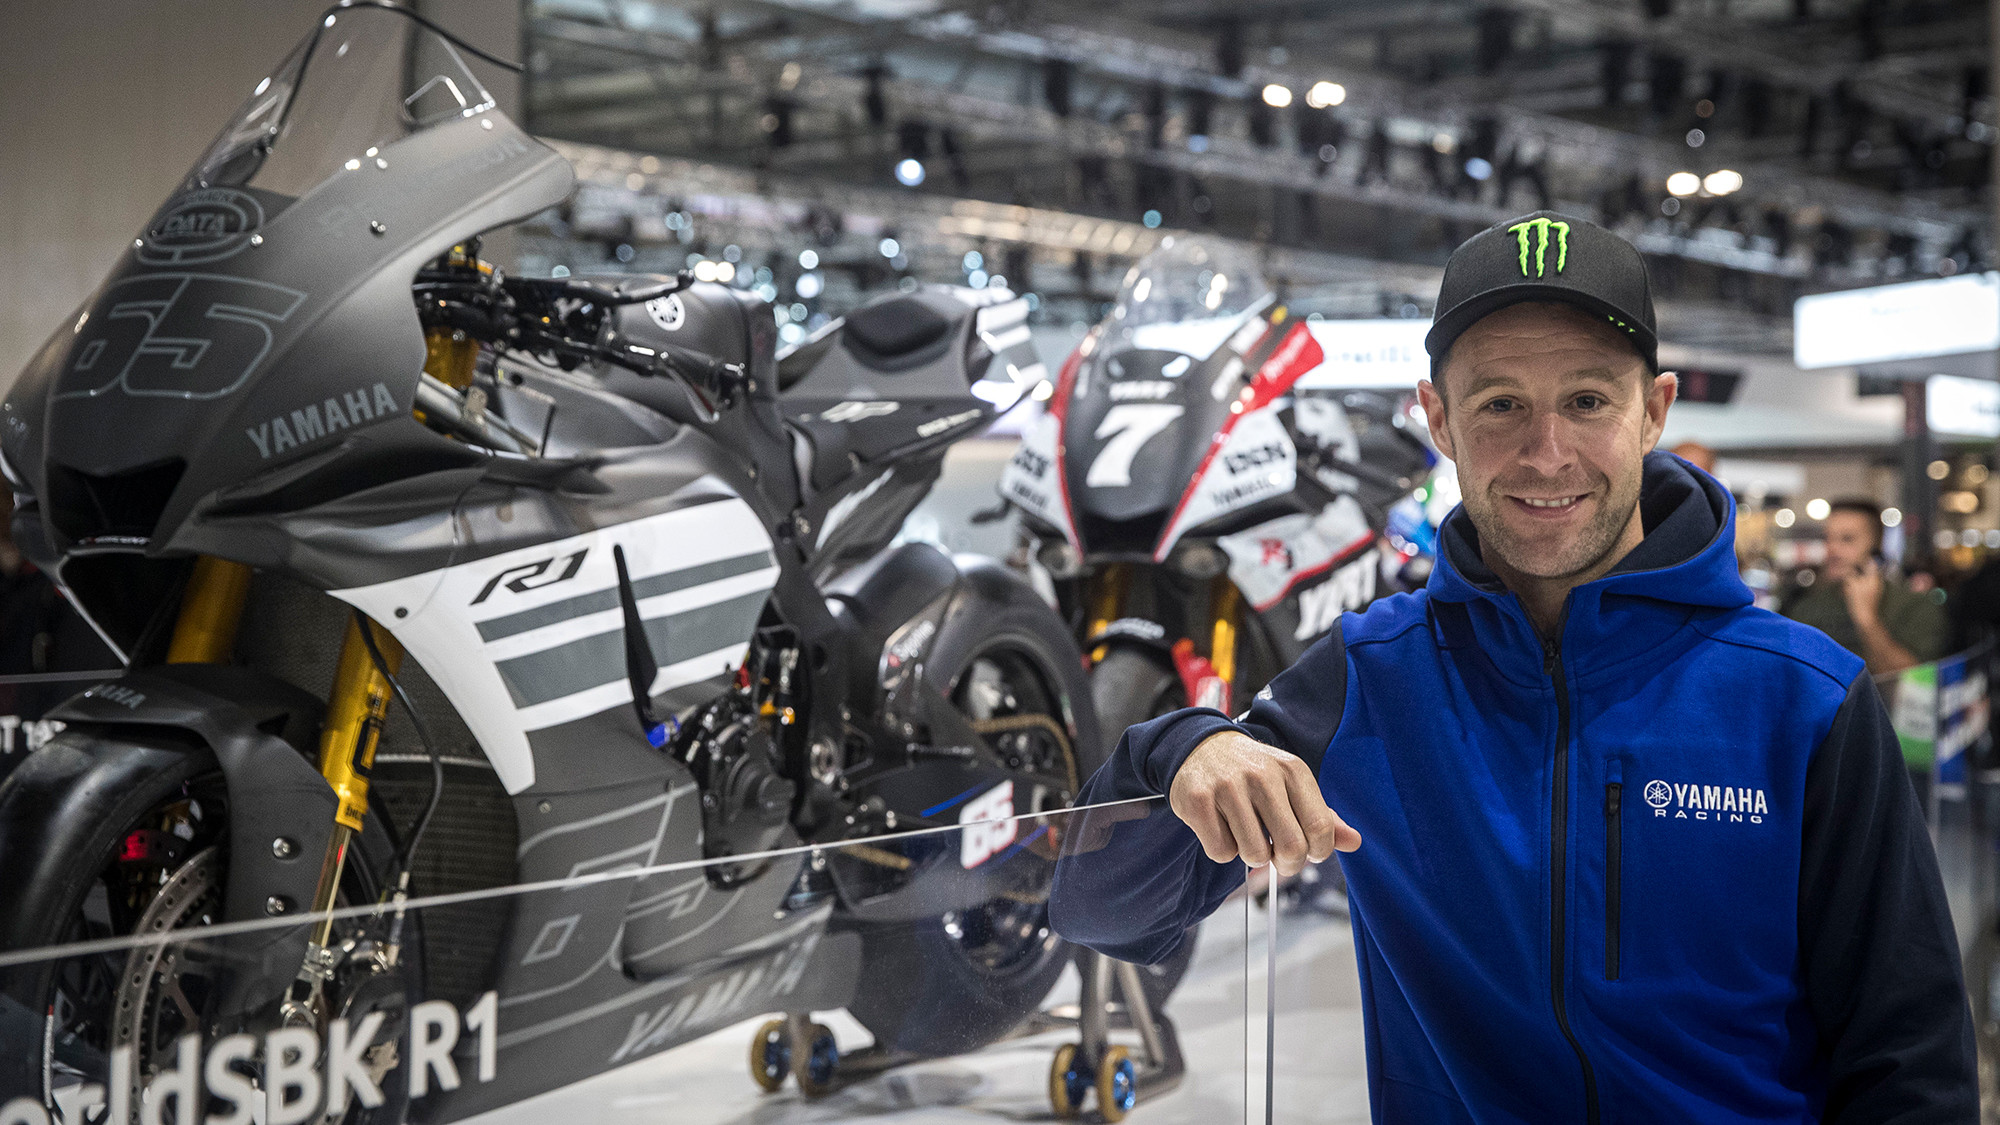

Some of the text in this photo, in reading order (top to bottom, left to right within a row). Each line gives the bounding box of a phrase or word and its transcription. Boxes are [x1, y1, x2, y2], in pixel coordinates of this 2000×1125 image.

[48, 272, 307, 400] 65
[245, 381, 399, 459] YAMAHA
[1086, 403, 1185, 488] 7
[468, 548, 590, 606] R1
[960, 779, 1018, 870] 65
[1655, 809, 1762, 824] RACING
[1674, 783, 1768, 814] YAMAHA
[409, 990, 498, 1099] R1
